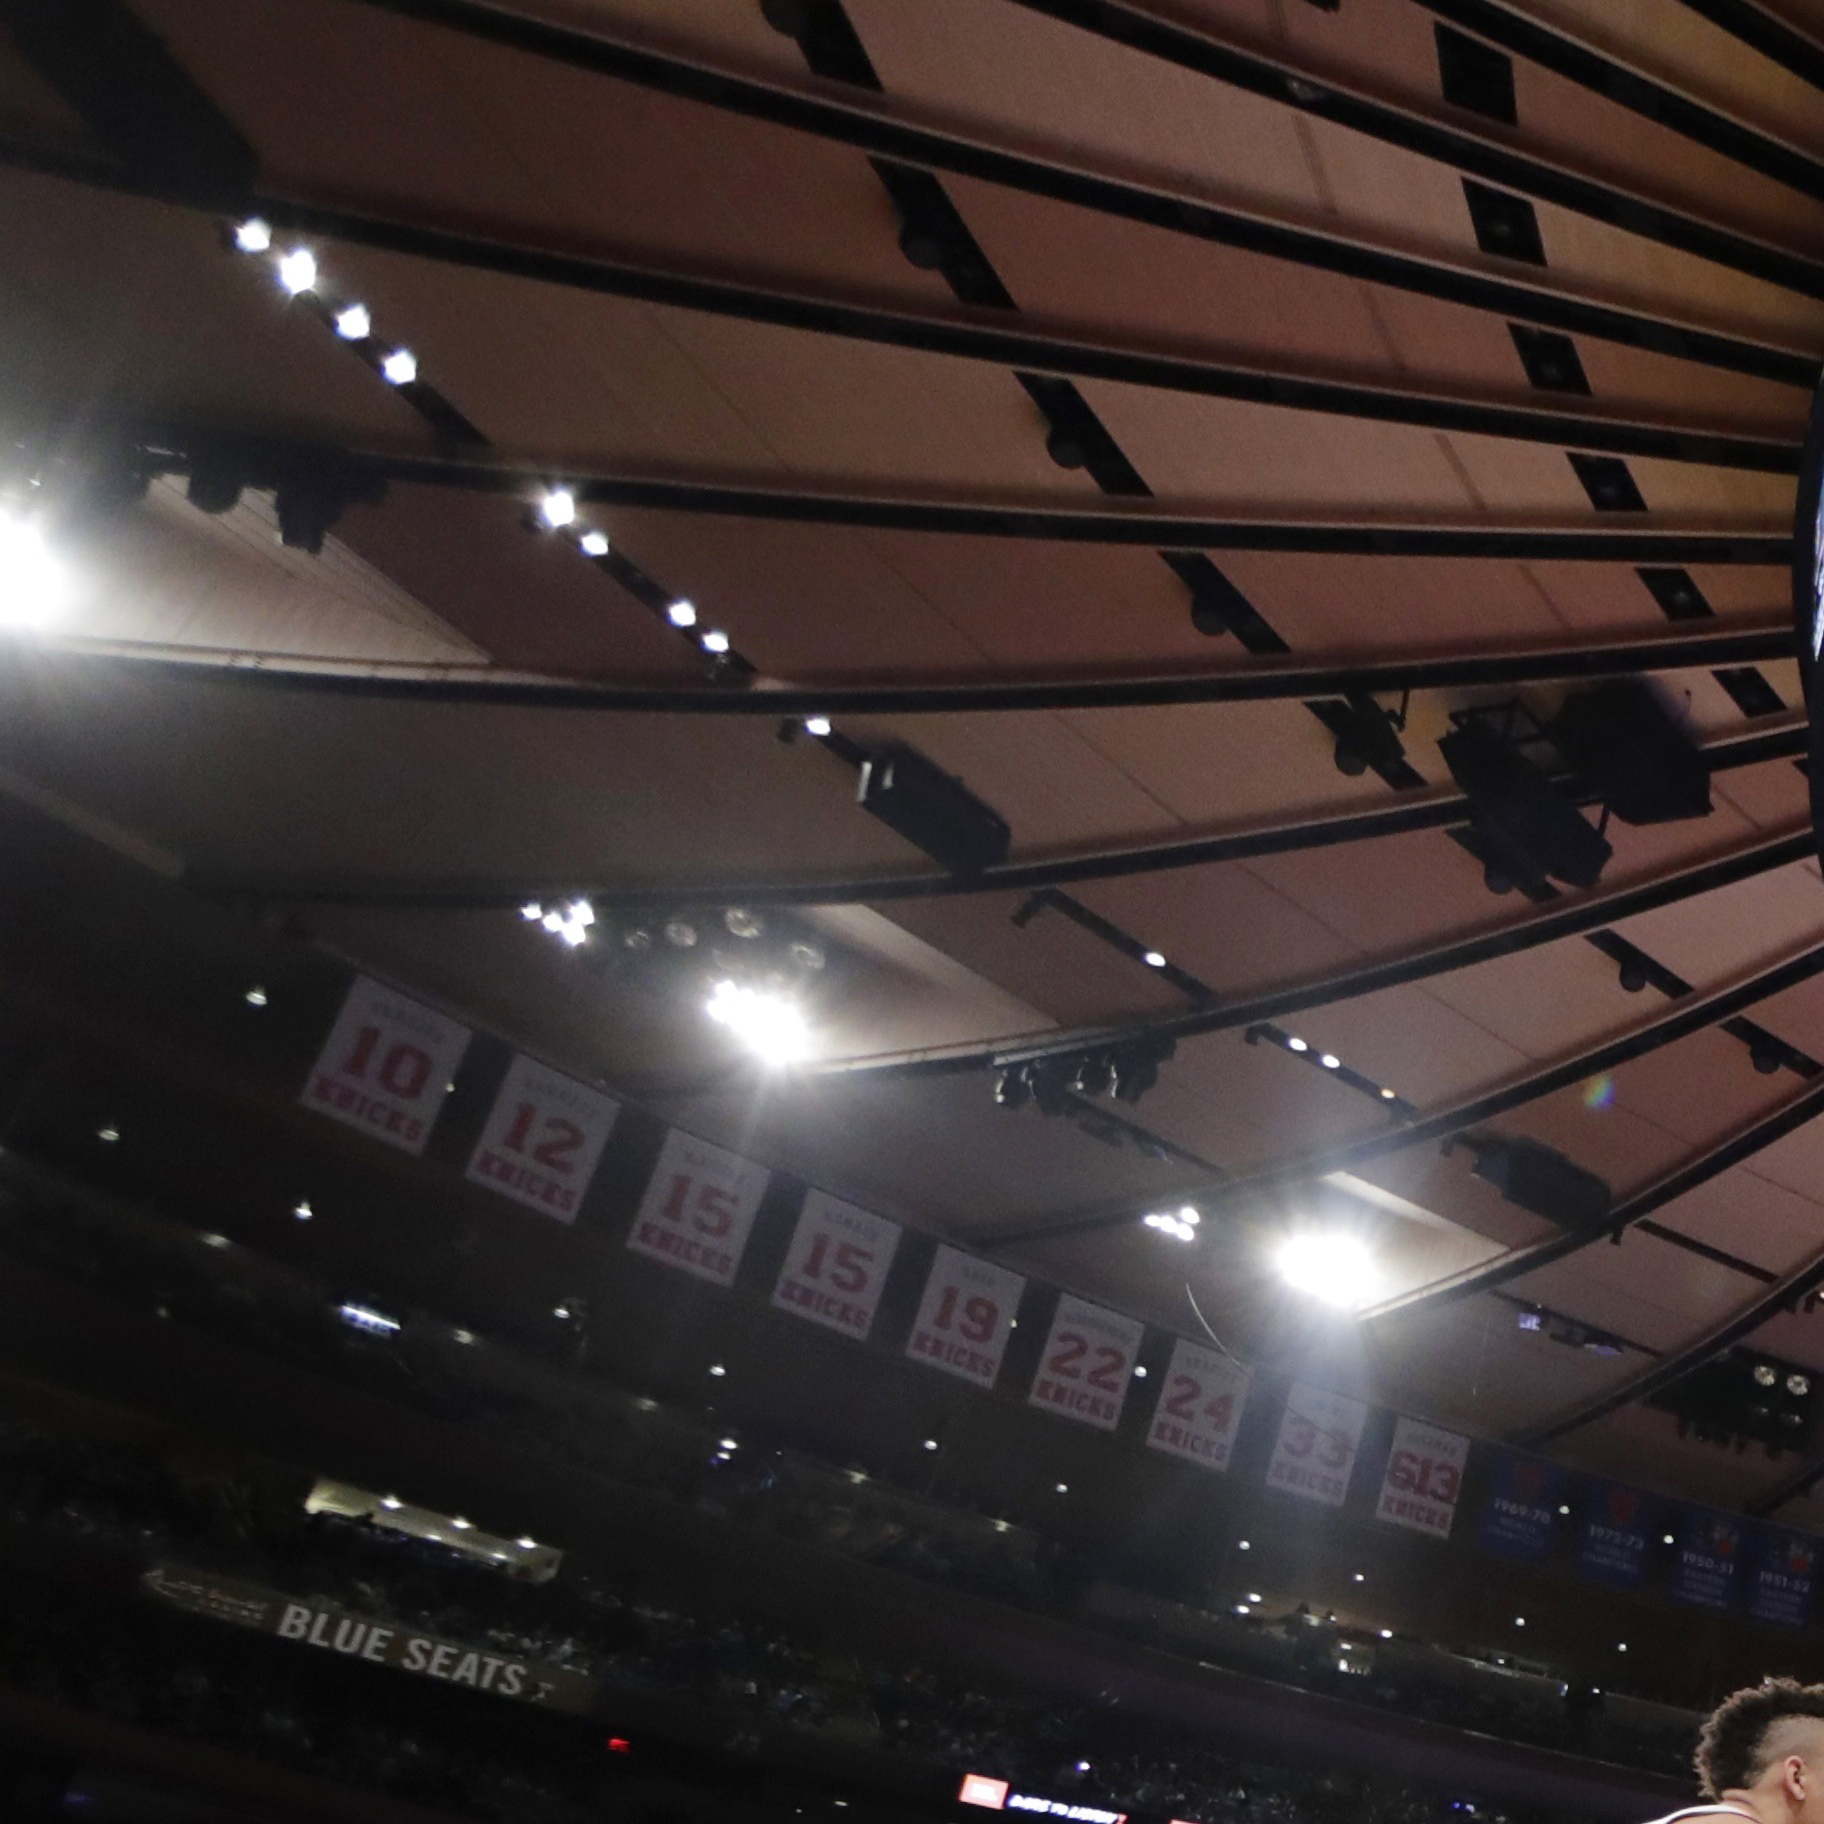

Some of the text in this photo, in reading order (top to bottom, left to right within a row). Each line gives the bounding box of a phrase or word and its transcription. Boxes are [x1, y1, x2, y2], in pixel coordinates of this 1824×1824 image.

[343, 1027, 432, 1098] 10
[503, 1103, 585, 1174] 12
[662, 1174, 739, 1238] 15
[803, 1232, 874, 1293] 15
[933, 1285, 998, 1343] 19
[913, 1331, 996, 1377] KNICKS
[1050, 1331, 1127, 1394] 22
[1166, 1373, 1234, 1433] 24
[1387, 1450, 1461, 1502] 613
[277, 1604, 530, 1696] BLUE SEATS
